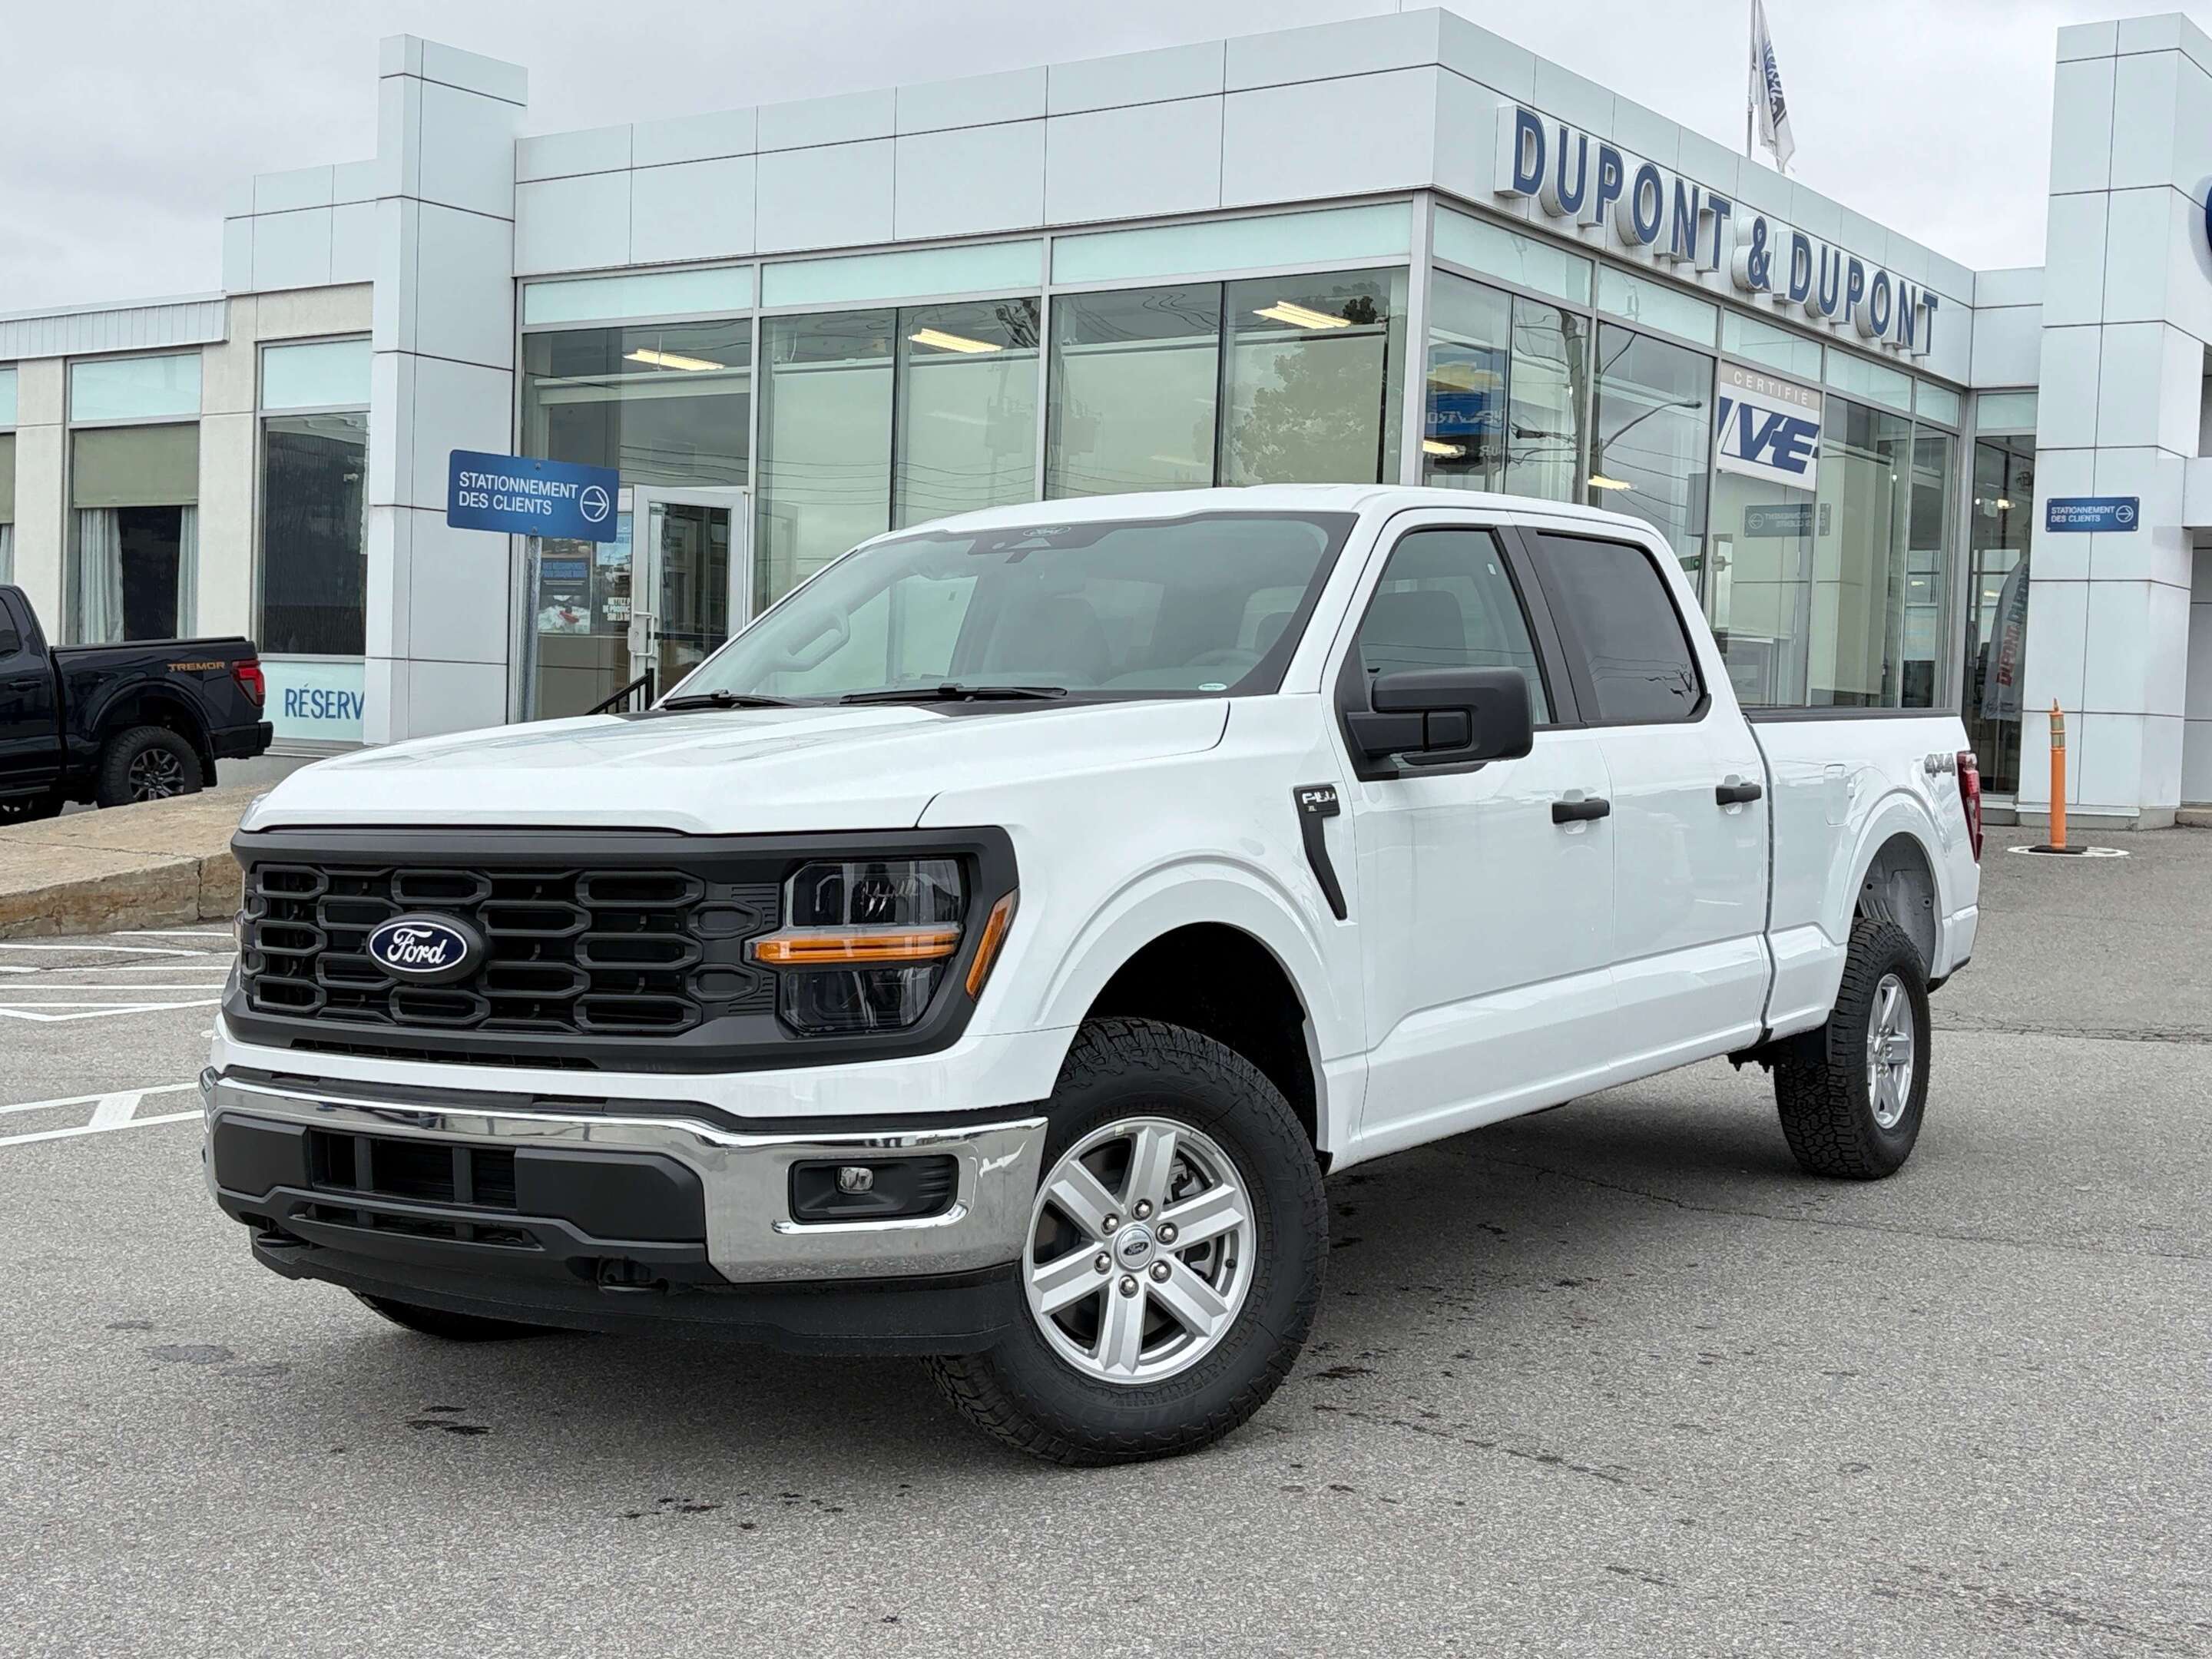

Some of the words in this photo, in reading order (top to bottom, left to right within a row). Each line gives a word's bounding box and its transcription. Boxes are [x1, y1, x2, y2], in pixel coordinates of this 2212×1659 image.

[1511, 104, 1732, 273] DUPONT
[1747, 215, 1772, 293] &
[1786, 230, 1939, 356] DUPONT
[1734, 370, 1808, 406] CERTIFIÉ
[459, 471, 578, 499] STATIONNEMENT
[459, 491, 488, 508] DES
[492, 495, 552, 515] CLIENTS
[2051, 505, 2115, 515] STATIONNEMENT
[167, 661, 226, 672] TREMOR
[285, 683, 364, 720] RÉSERV
[387, 928, 448, 964] Ford
